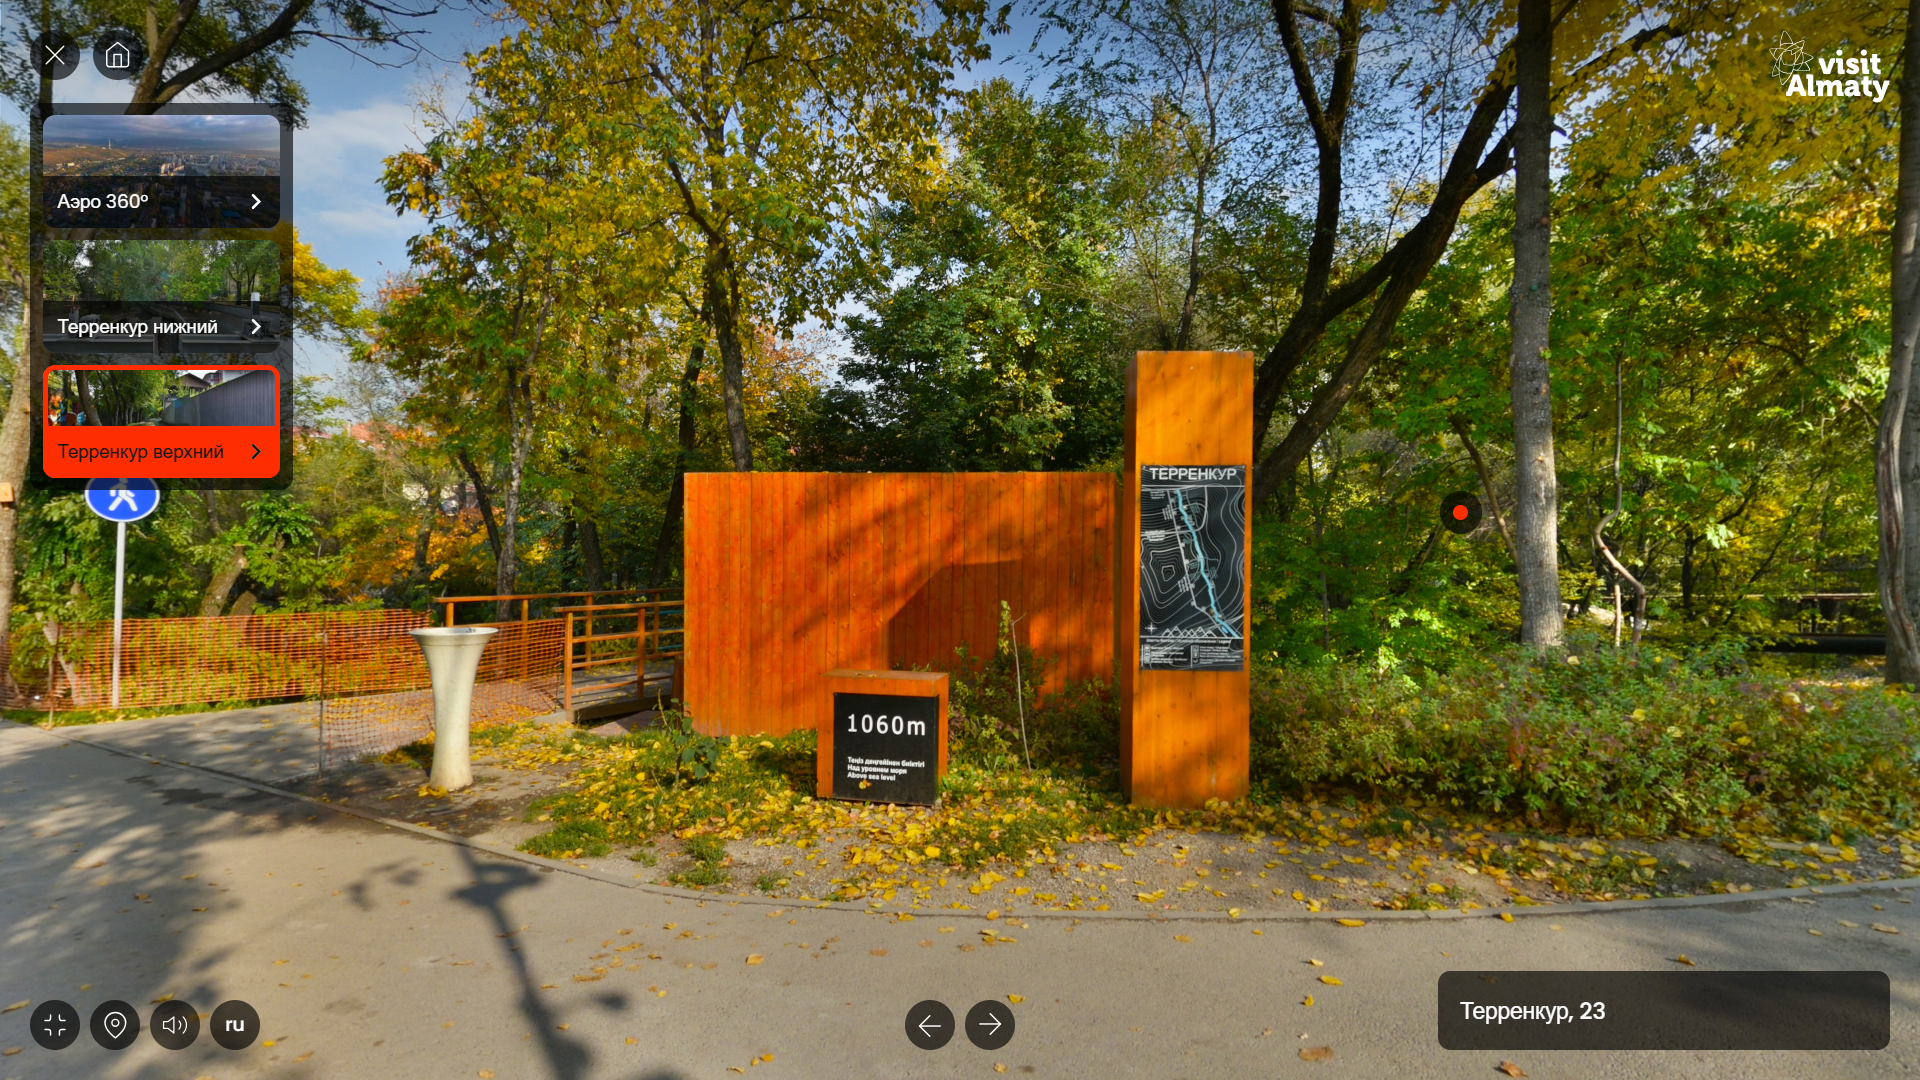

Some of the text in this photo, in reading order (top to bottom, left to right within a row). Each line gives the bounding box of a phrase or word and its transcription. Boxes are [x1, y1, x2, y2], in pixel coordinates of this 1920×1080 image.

[1149, 467, 1237, 481] ТЕРРЕНКУР
[848, 713, 925, 736] 1060m
[847, 764, 861, 772] Над
[847, 771, 867, 779] Above
